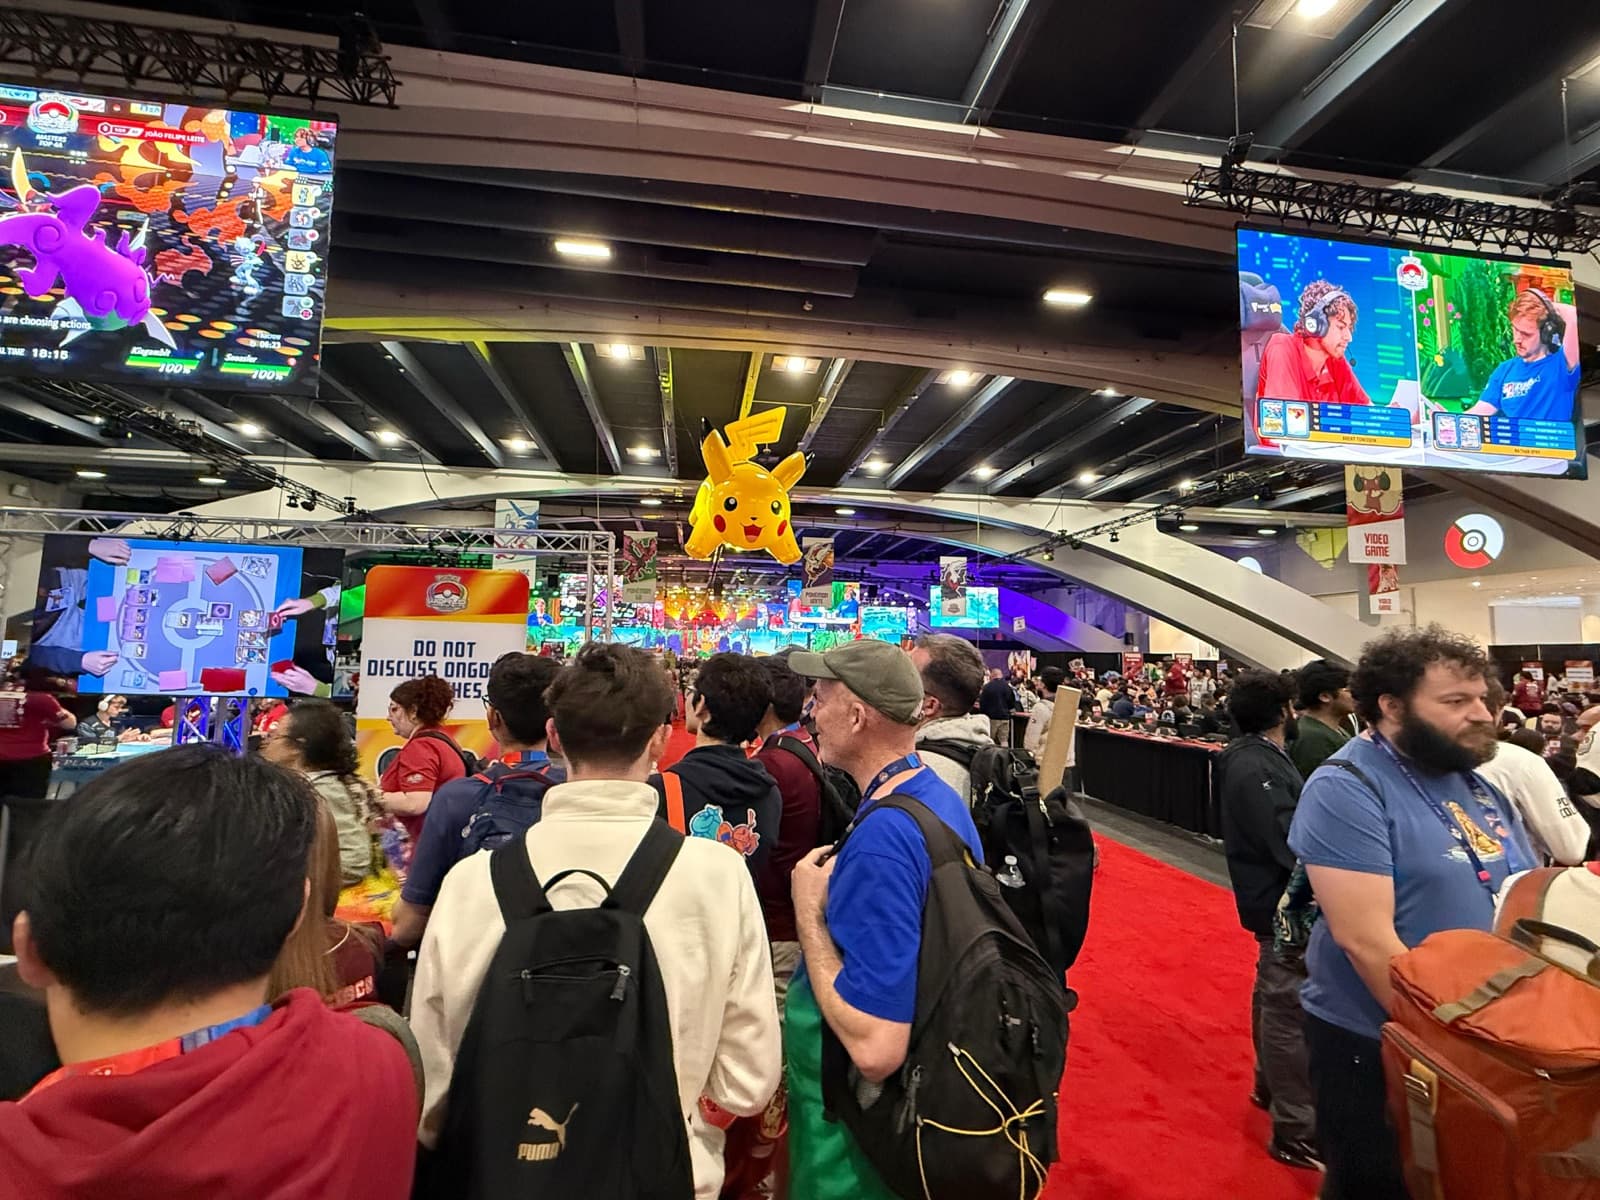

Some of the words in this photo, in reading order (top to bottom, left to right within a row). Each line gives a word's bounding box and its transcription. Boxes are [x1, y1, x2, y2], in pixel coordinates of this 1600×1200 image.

[3, 316, 18, 324] are
[20, 315, 59, 330] choosing
[60, 319, 92, 329] actions
[158, 362, 191, 374] 100%
[251, 369, 284, 381] 100%
[1364, 533, 1389, 544] VIDEO
[1365, 545, 1389, 557] GAME
[413, 640, 436, 657] DO
[443, 641, 476, 658] NOT
[367, 659, 438, 677] DISCUSS
[450, 682, 482, 698] HES
[517, 1142, 560, 1161] PUMA
